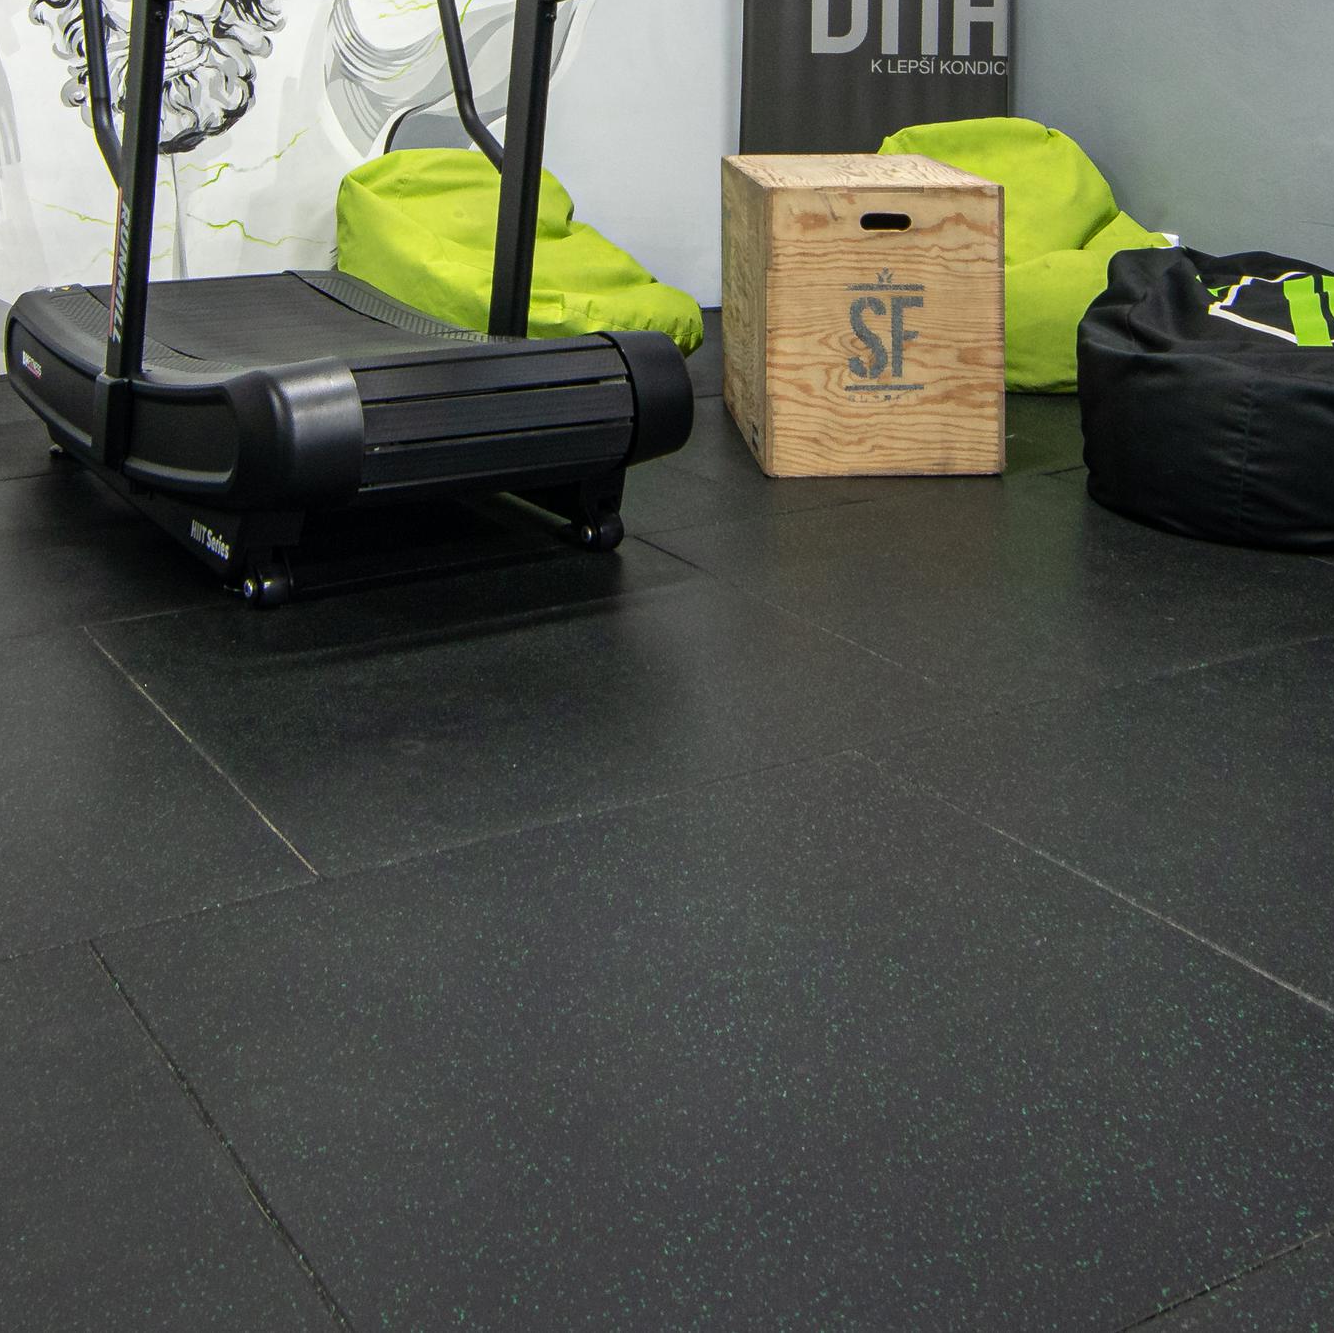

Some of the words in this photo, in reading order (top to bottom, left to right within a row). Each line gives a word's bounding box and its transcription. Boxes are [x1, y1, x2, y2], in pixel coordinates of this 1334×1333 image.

[871, 59, 883, 74] K
[887, 55, 937, 75] LEPŠÍ
[847, 295, 924, 379] SF
